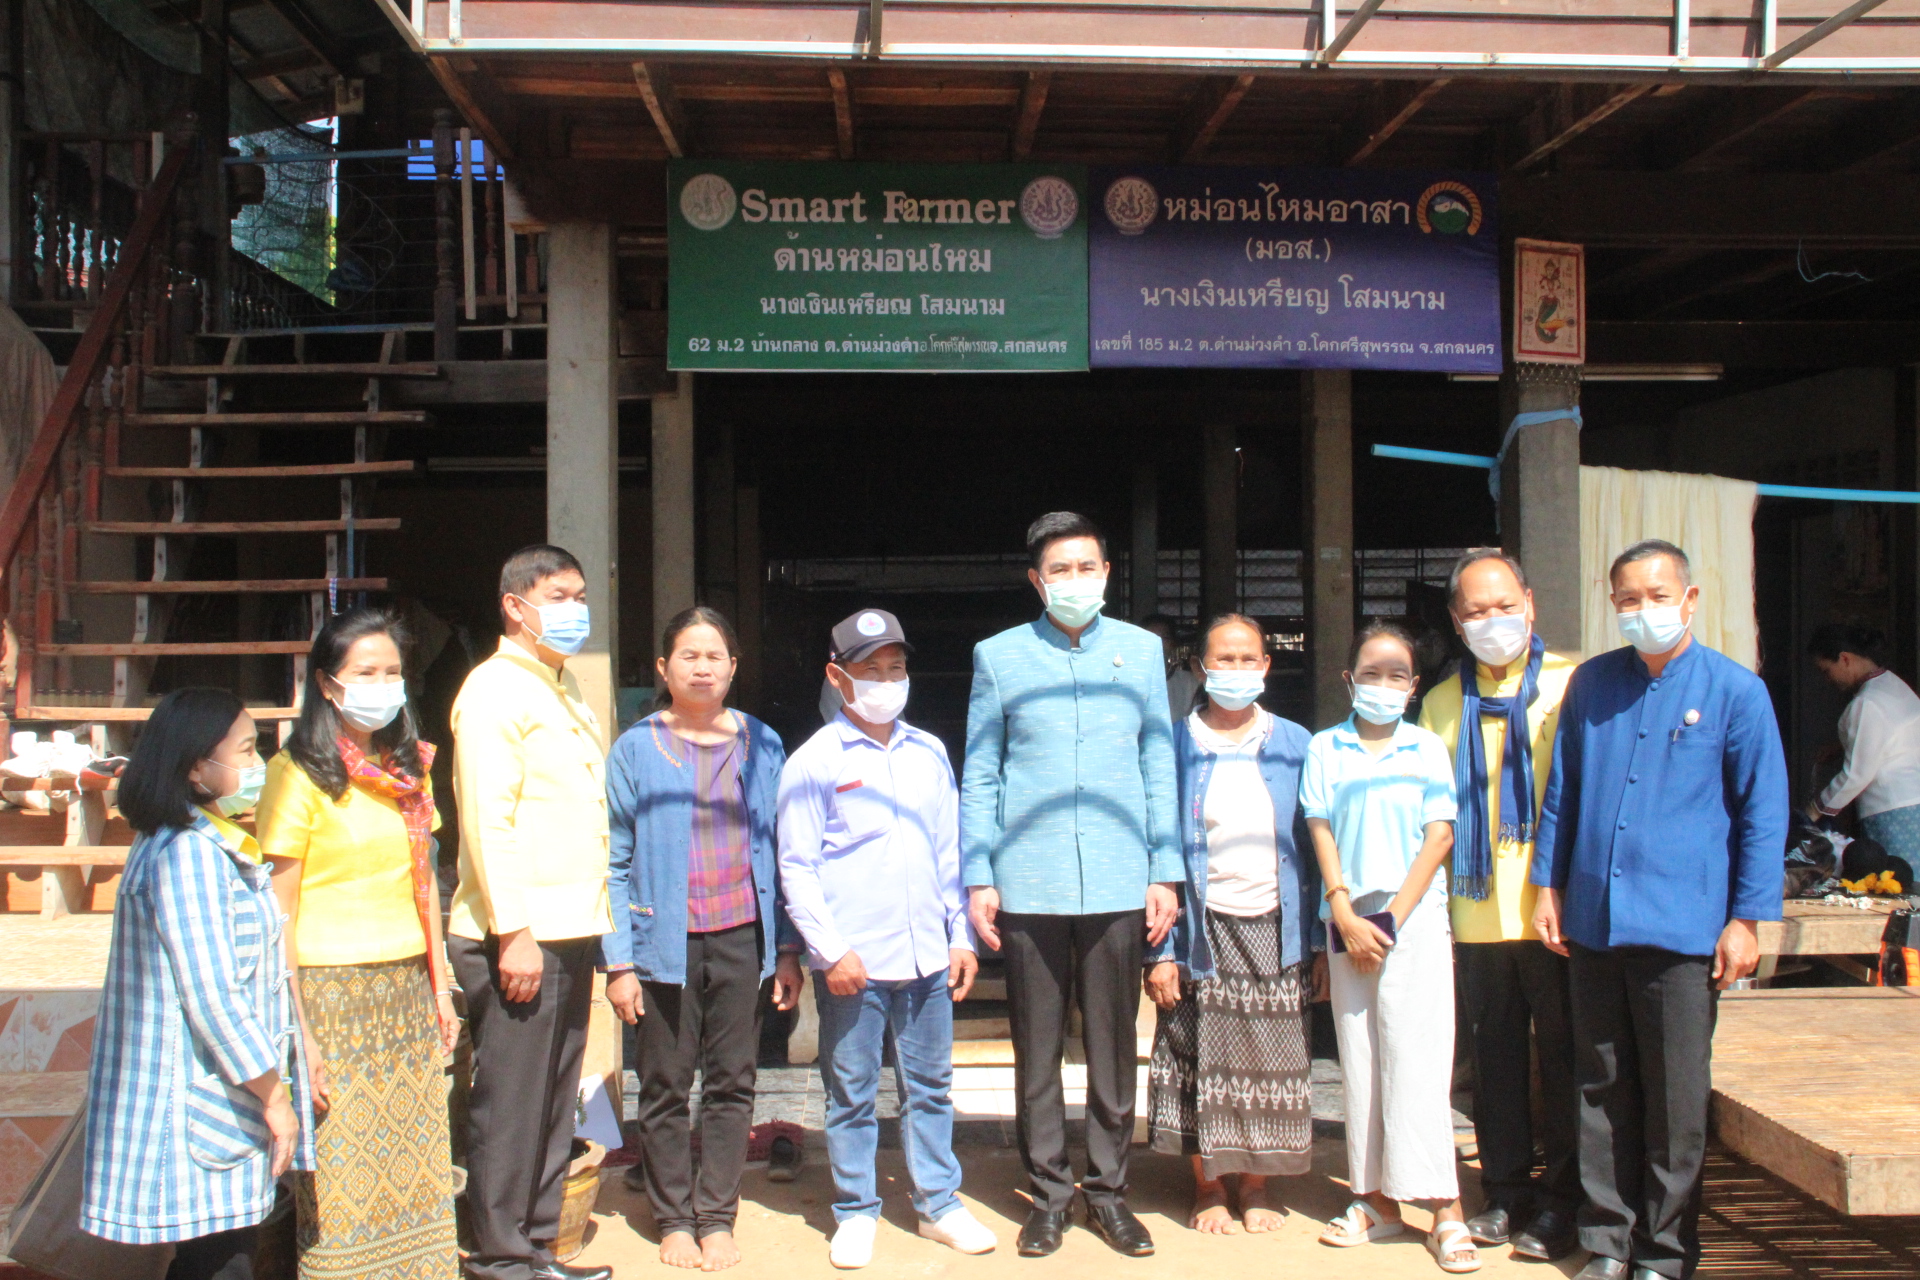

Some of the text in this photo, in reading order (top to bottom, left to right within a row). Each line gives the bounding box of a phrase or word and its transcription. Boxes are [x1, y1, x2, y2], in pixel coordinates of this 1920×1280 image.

[741, 188, 1016, 224] Smart Farmer
[1163, 182, 1411, 225] หม่อนไหมอาสา
[774, 231, 992, 273] ด้านหม่อนไหม
[1245, 237, 1332, 263] (มอส.)
[760, 292, 1006, 315] นางเงินเหรียญ โสมนาม
[1140, 273, 1446, 315] นางเงินเหรียญ โสมนาม
[688, 337, 711, 353] 62
[716, 337, 745, 353] ม.2
[751, 332, 819, 353] บ้านกลาง
[1095, 331, 1133, 352] เลขที่
[1138, 336, 1164, 352] 185
[1168, 337, 1194, 352] ม.2
[1296, 331, 1415, 360] อ.โคกศรีสุพรรณ
[1419, 342, 1495, 355] จ.สกลนคร
